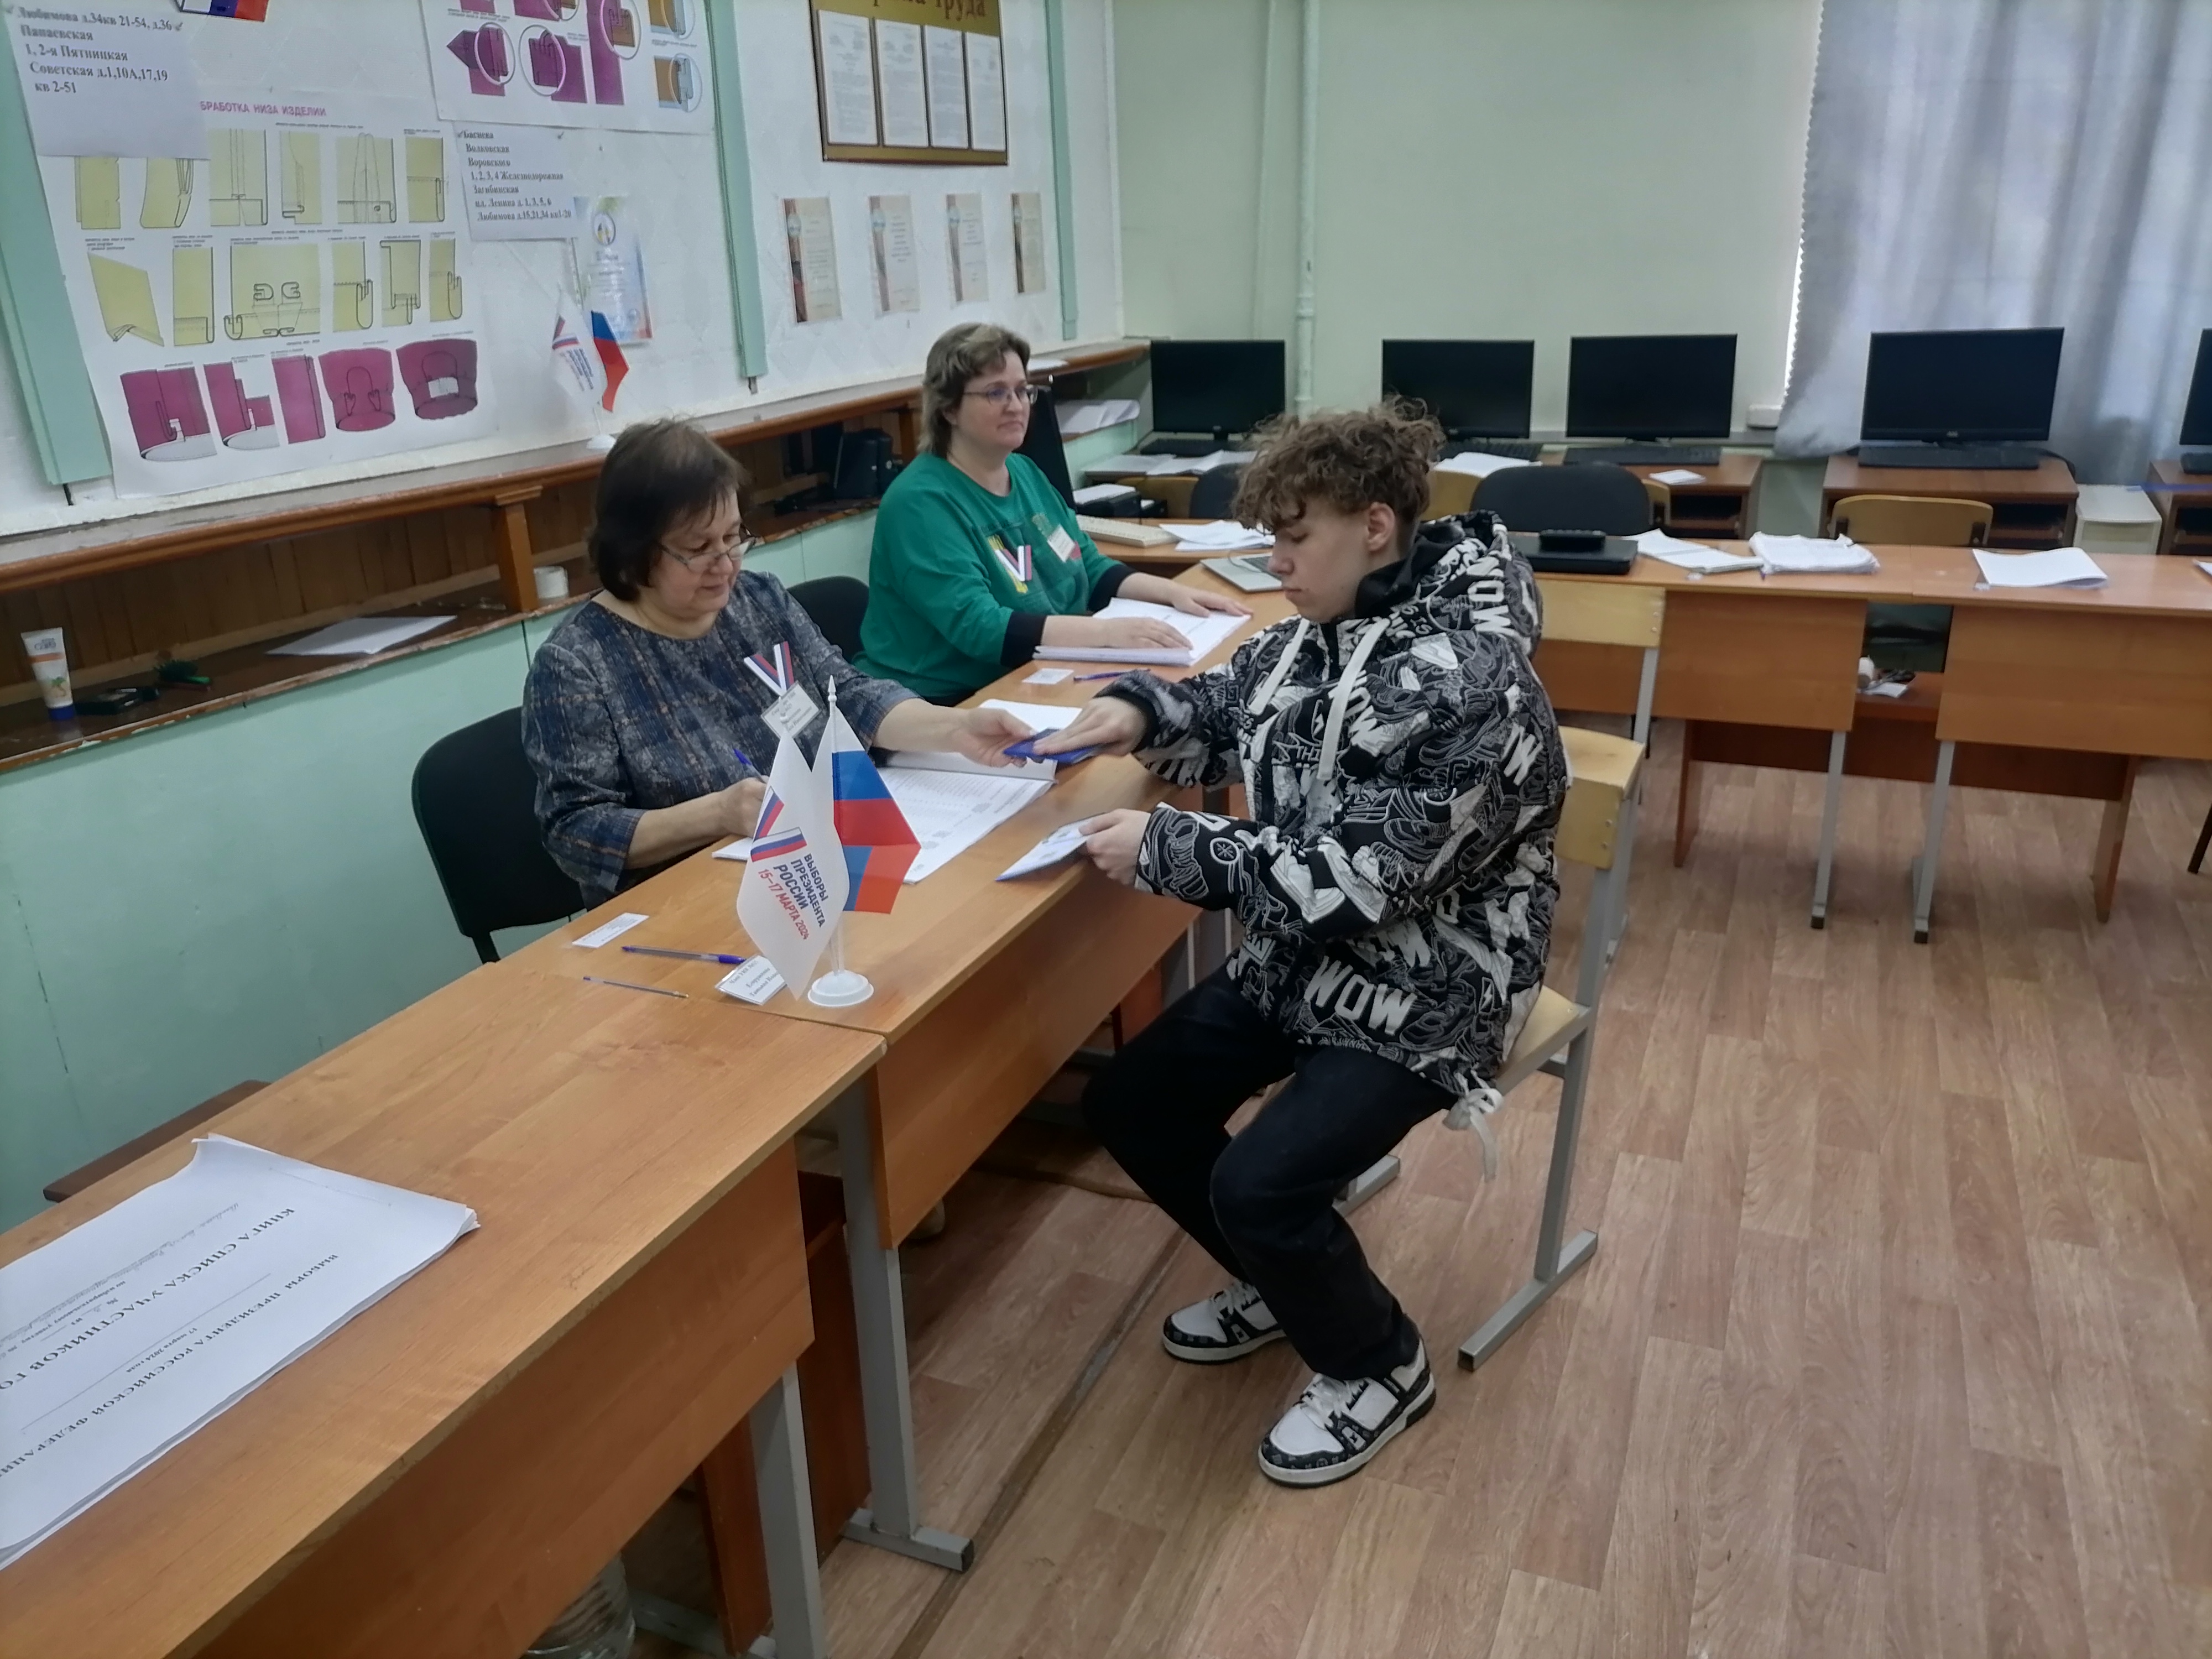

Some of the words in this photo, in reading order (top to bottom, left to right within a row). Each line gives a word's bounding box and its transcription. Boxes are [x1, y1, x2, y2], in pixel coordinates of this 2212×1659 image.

[936, 0, 986, 21] руда
[30, 61, 93, 76] Советская
[60, 45, 128, 61] Пятницкая
[52, 81, 76, 93] 2-51
[200, 101, 249, 112] БРАБОТКА
[253, 105, 278, 114] НИЗА
[466, 143, 509, 153] Волковская
[468, 157, 510, 168] Воровского
[477, 212, 515, 221] Любимова
[488, 198, 515, 207] Ленина
[773, 864, 808, 909] РОССИИ
[791, 859, 826, 927] ПРЕЗИДЕНТА
[804, 853, 828, 901] ВЫБОРЫ
[776, 893, 801, 921] МАРТА
[796, 920, 809, 940] 2024
[1303, 956, 1418, 1036] WOW
[238, 1208, 295, 1241] КНИГА
[164, 1243, 237, 1287] СПИСКА
[284, 1254, 339, 1290] ВЫБОРЫ
[29, 1290, 163, 1370] УЧАСТНИКОВ
[194, 1292, 281, 1346] ПРЕЗИДЕНТА
[145, 1348, 164, 1361] 2024
[91, 1347, 194, 1416] РОССИЙСКОЙ
